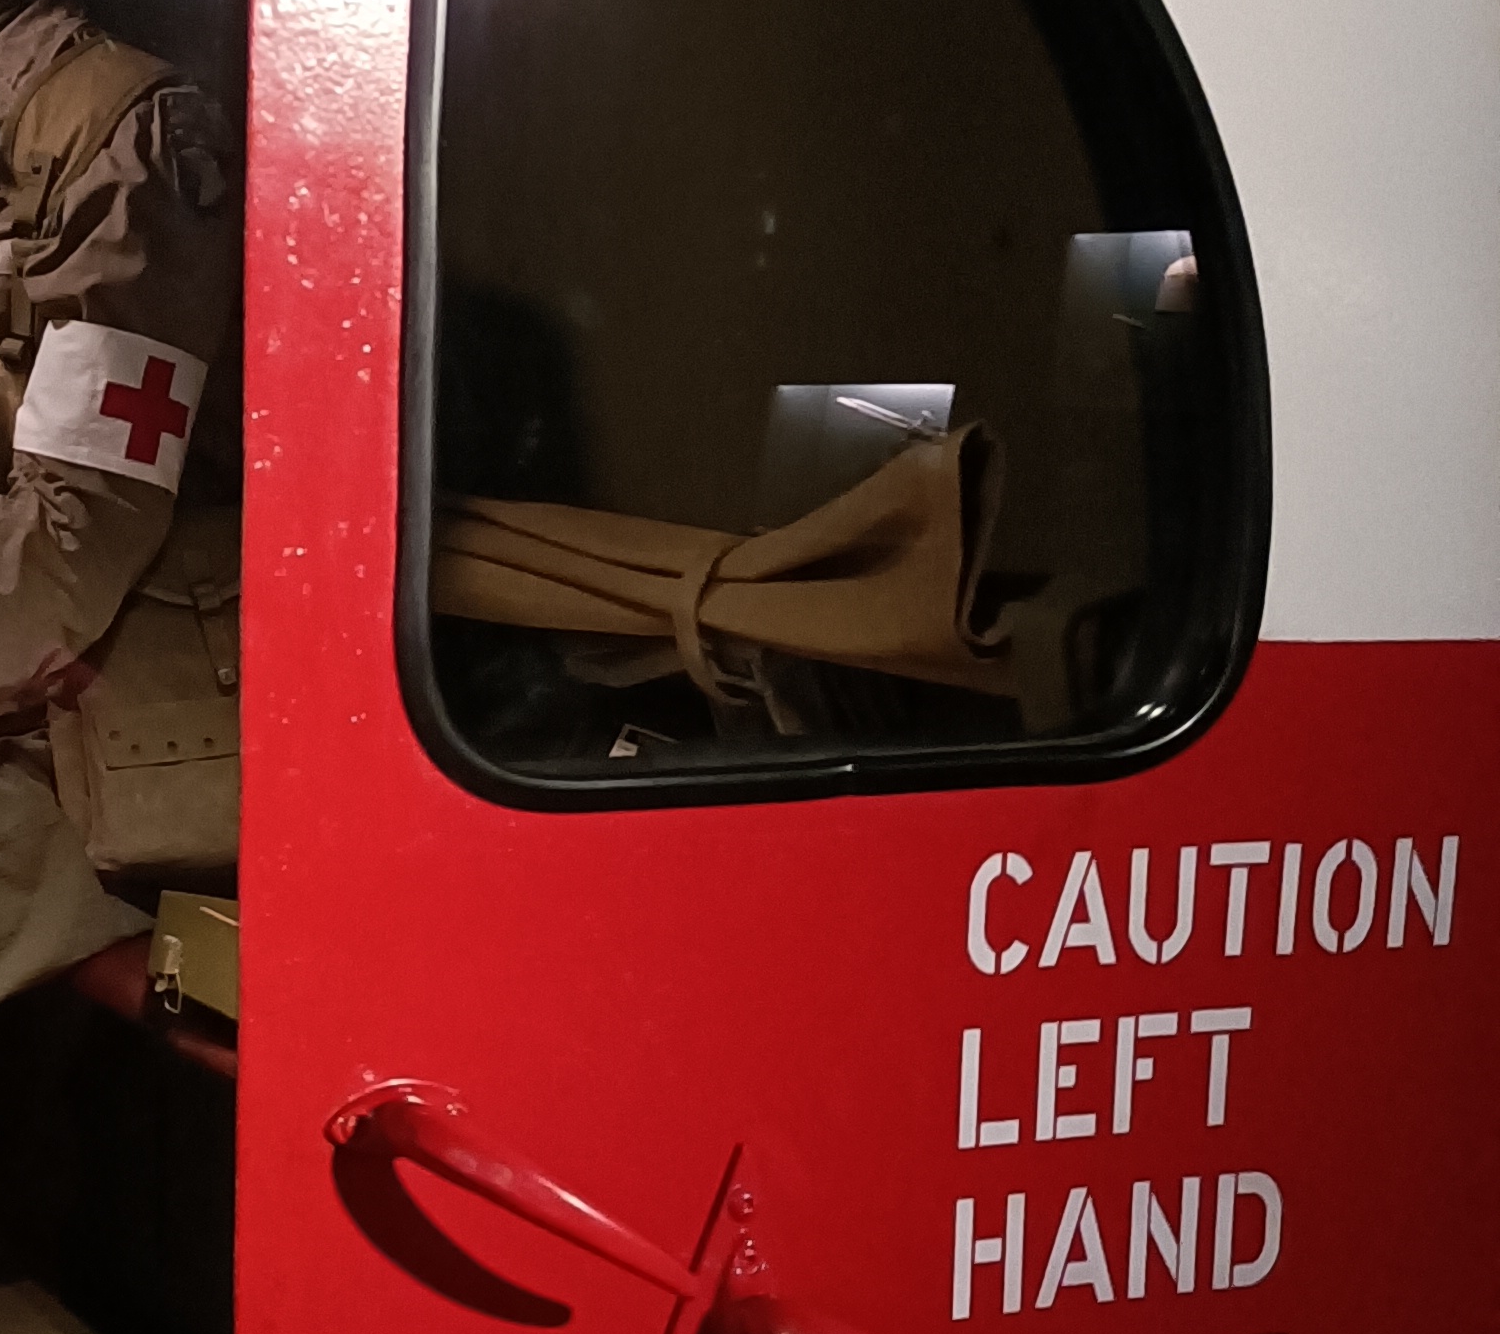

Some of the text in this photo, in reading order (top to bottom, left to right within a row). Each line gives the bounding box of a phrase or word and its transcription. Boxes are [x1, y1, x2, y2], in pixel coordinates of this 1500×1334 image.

[967, 835, 1459, 975] CAUTION
[958, 1006, 1252, 1150] LEFT
[952, 1171, 1283, 1320] HAND
